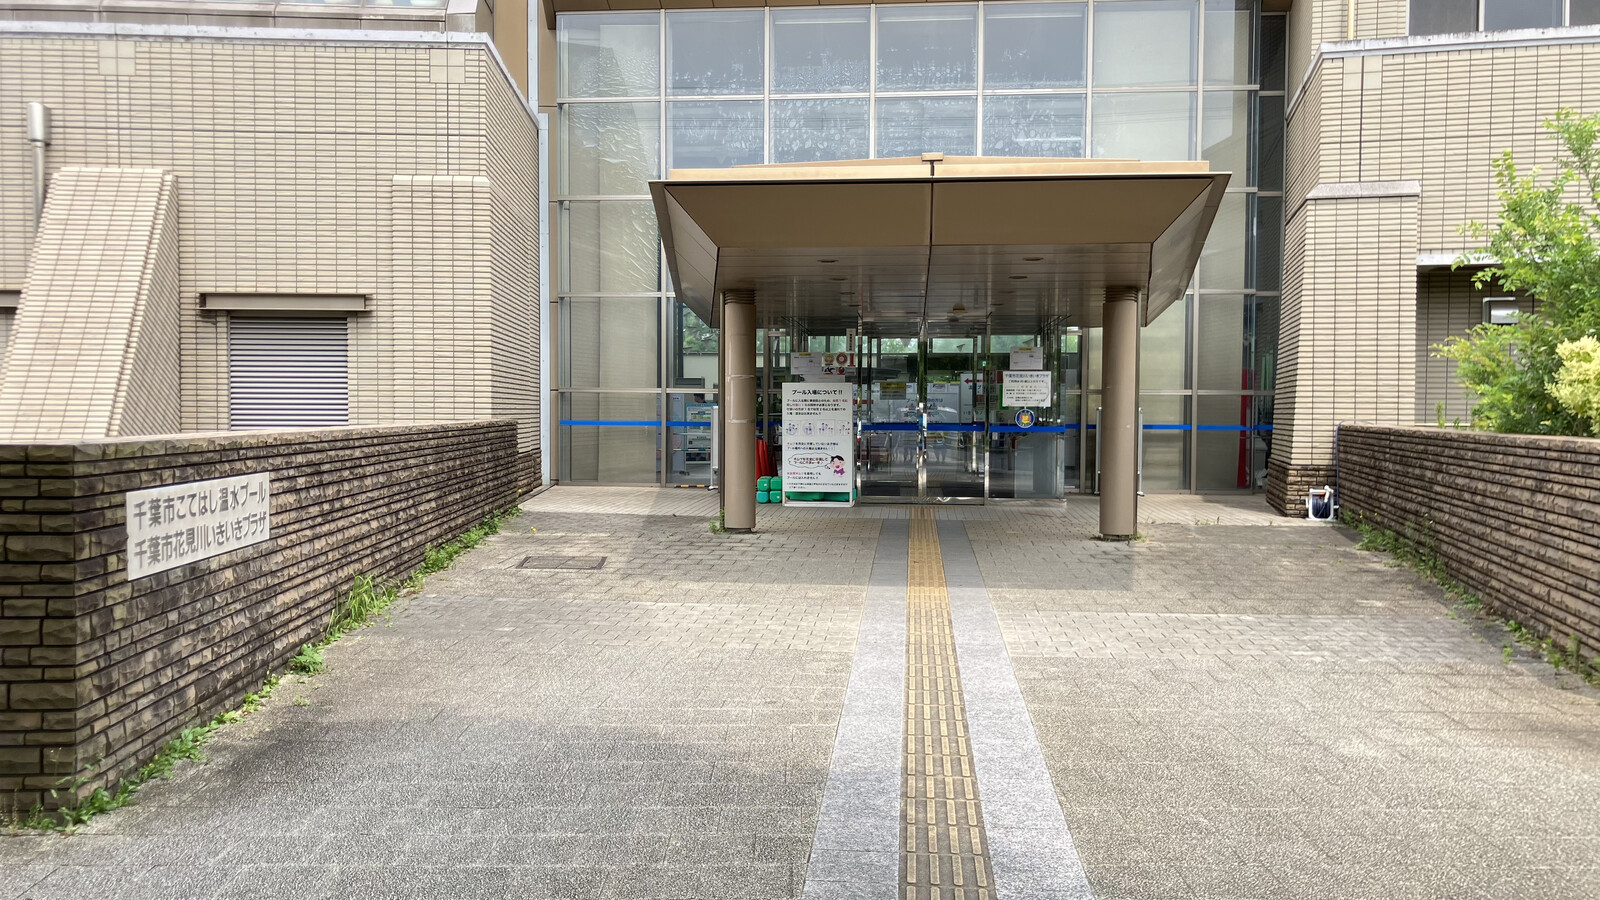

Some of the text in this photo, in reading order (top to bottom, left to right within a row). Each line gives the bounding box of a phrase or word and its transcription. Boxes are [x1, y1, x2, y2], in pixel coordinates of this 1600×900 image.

[133, 481, 266, 532] 千葉市こてはし温水プール
[134, 511, 267, 570] 千葉市花見川いきいきプラザ
